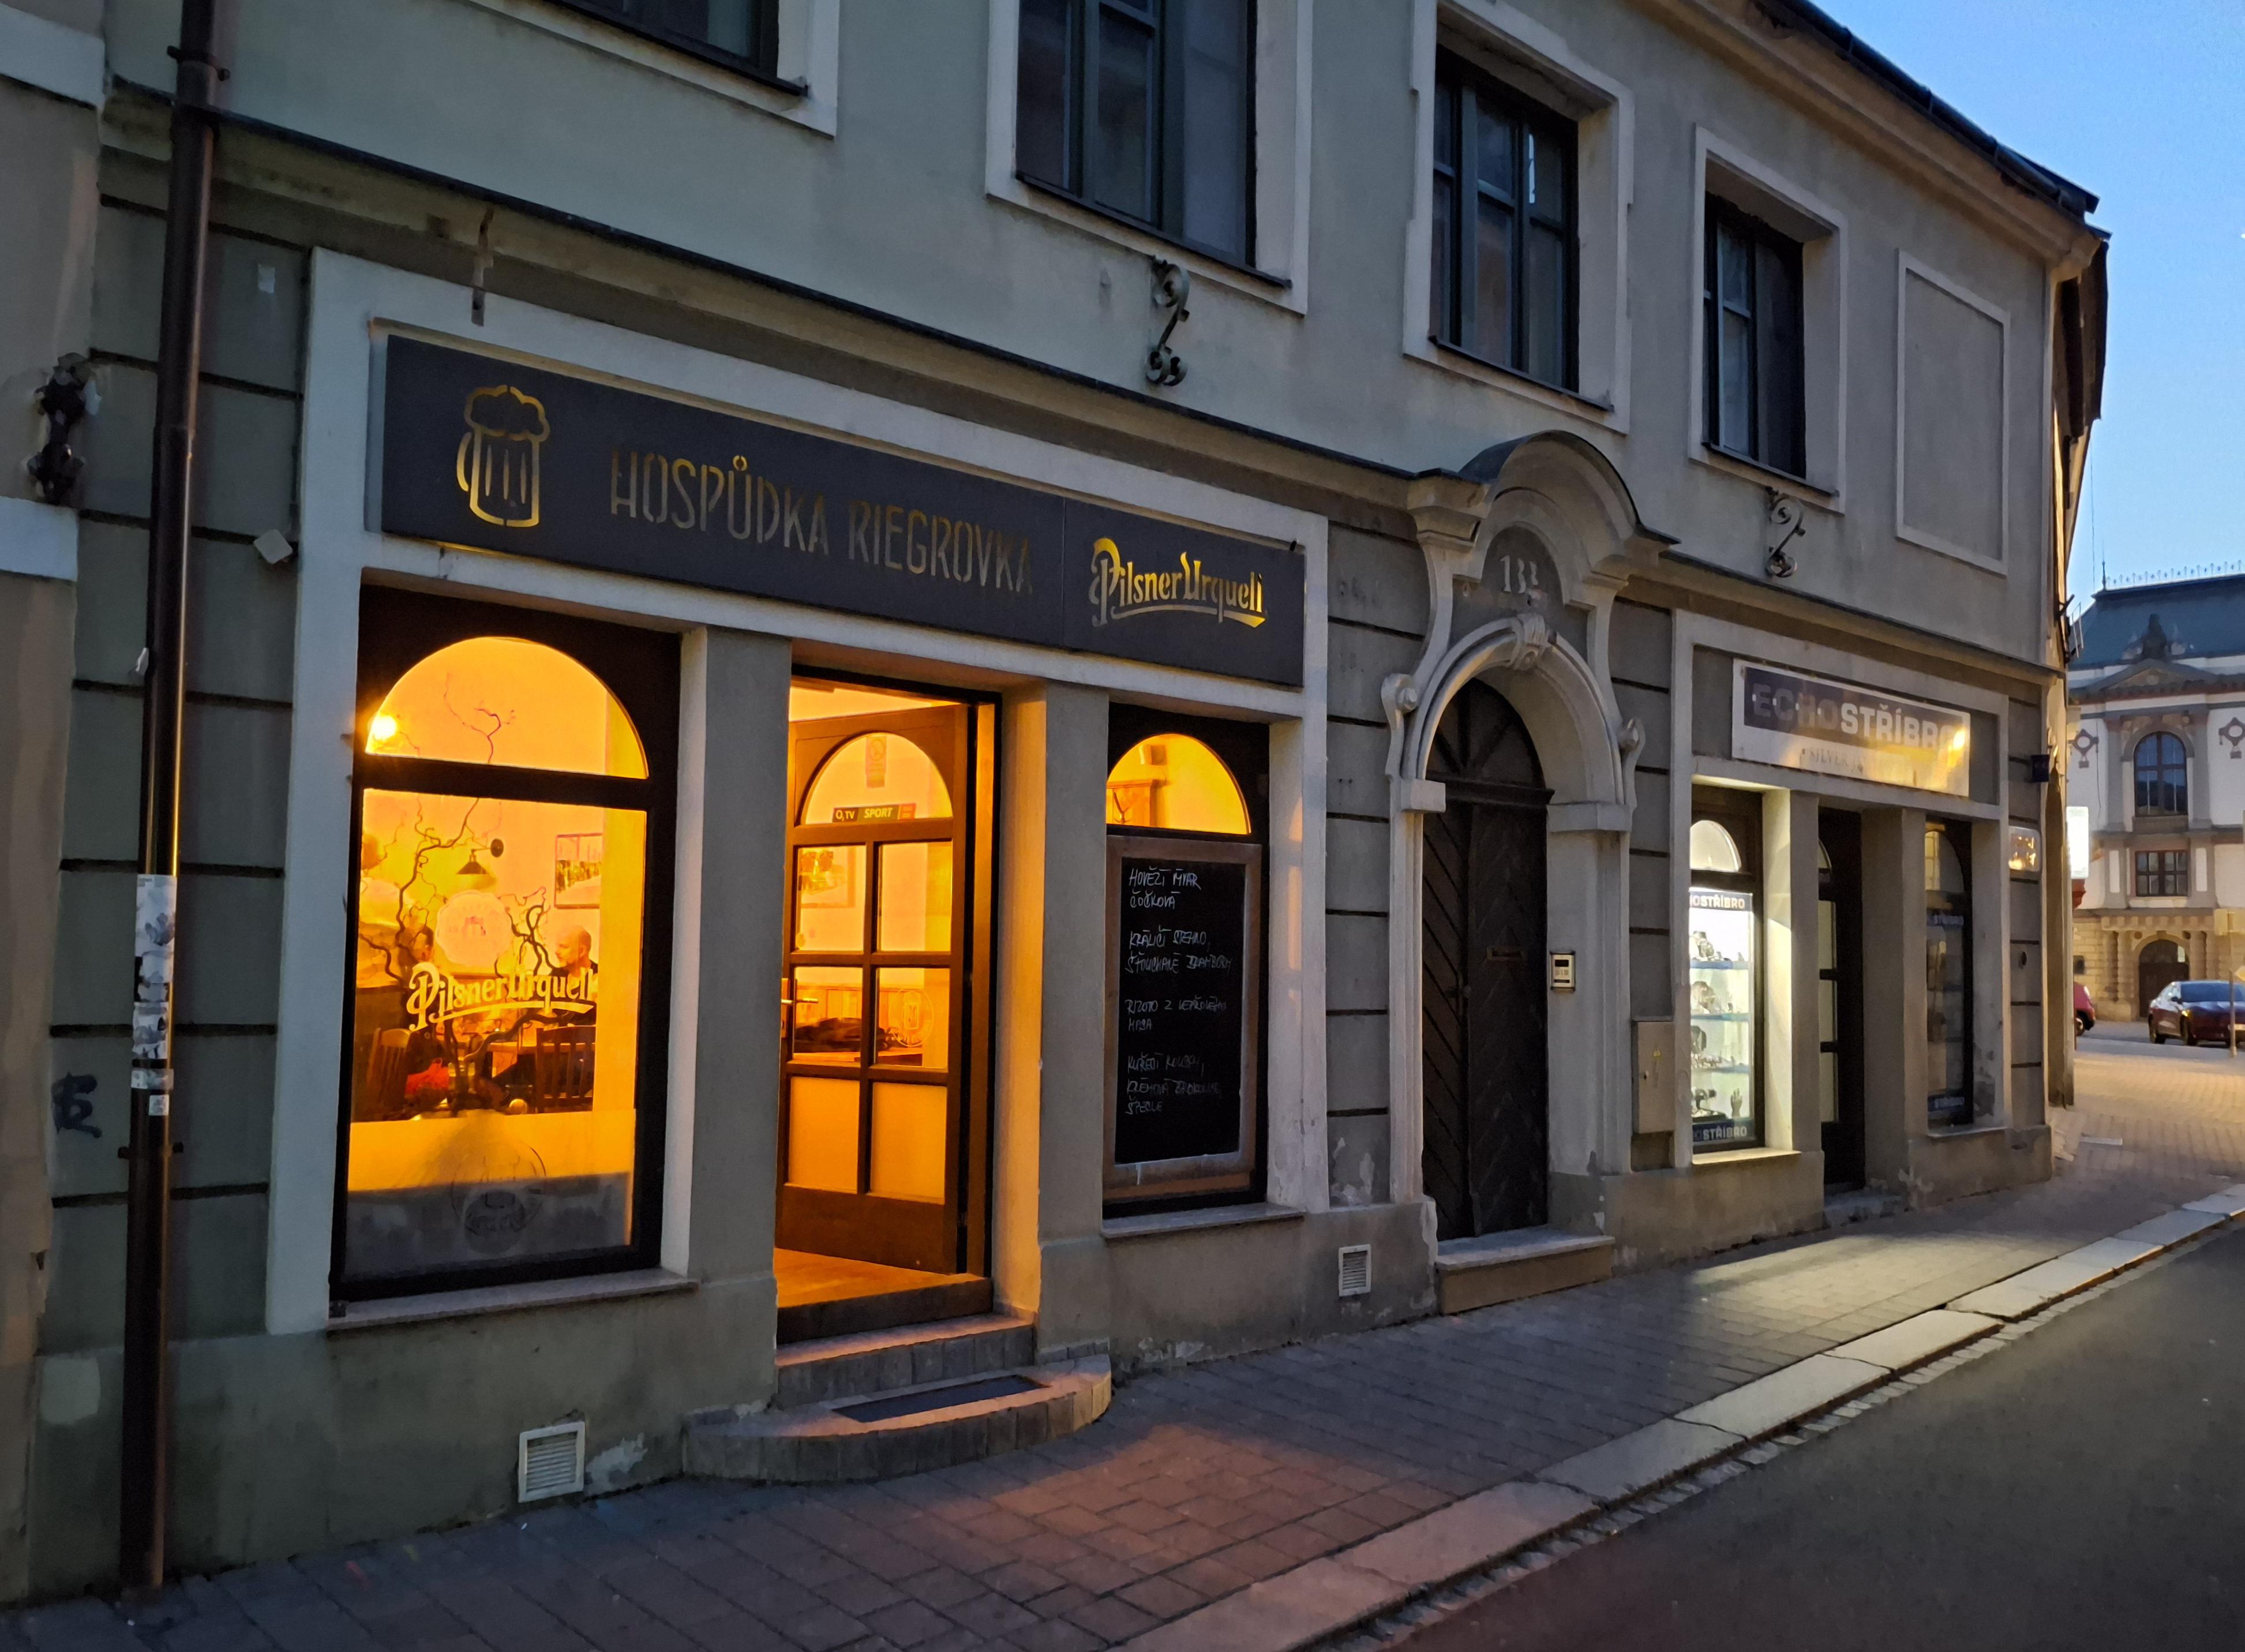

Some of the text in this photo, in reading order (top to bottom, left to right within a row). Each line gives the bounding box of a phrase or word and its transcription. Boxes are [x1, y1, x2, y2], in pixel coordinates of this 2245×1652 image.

[611, 447, 1033, 595] HOSPŮDKA RIEGROVKA
[1089, 538, 1262, 628] Pilsner Urquell
[864, 808, 893, 819] SPORT
[407, 962, 594, 1032] Pilsner Urquell
